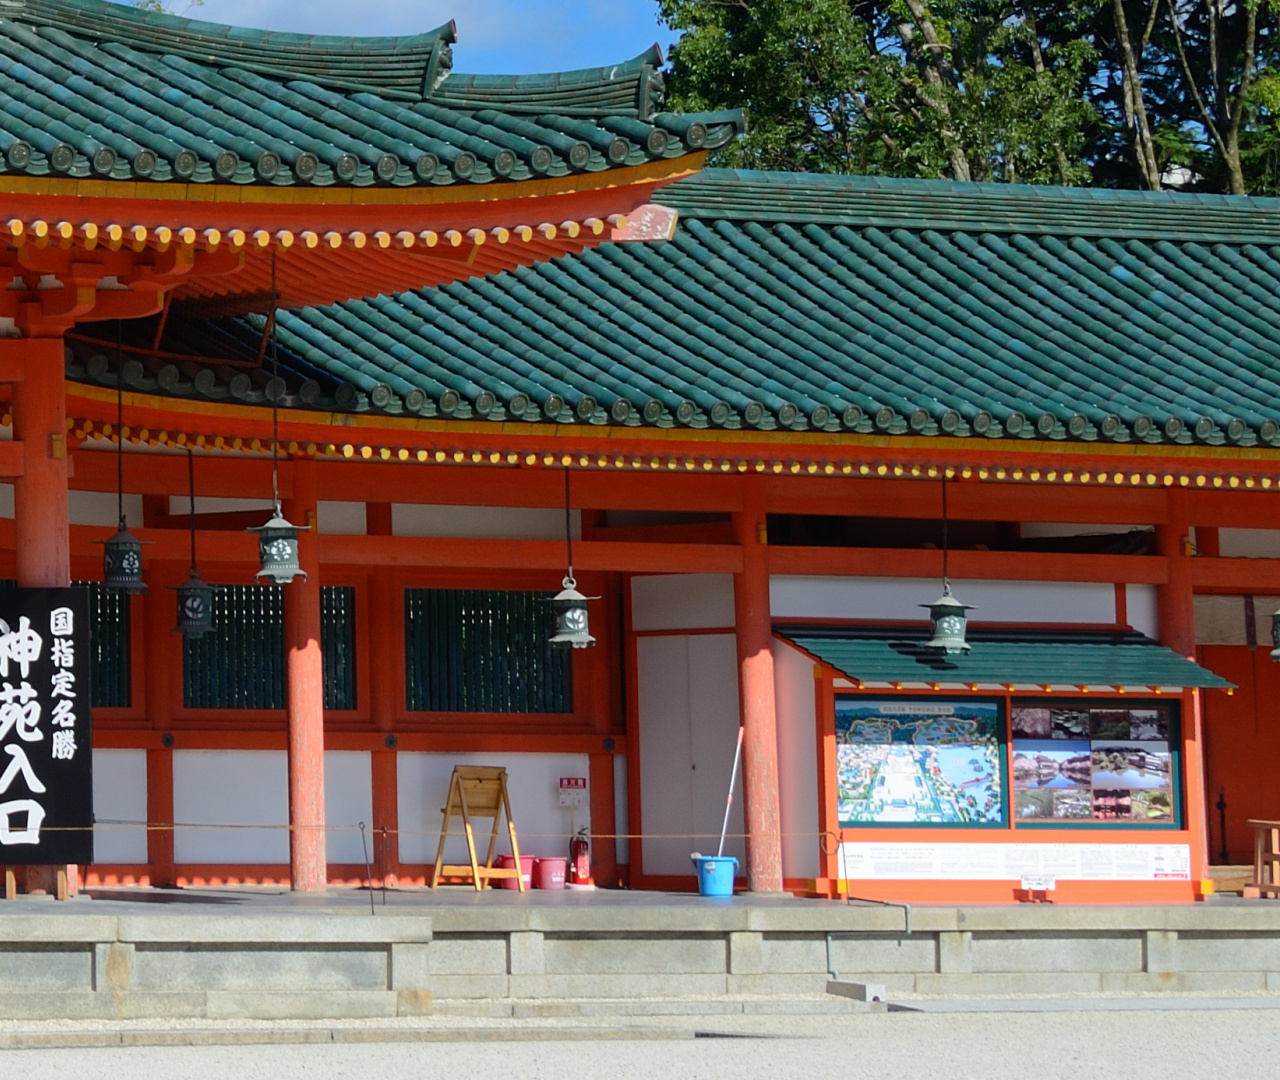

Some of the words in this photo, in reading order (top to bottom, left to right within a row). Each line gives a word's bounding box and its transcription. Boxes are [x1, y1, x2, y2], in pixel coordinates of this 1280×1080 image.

[50, 607, 77, 760] 国指定名勝
